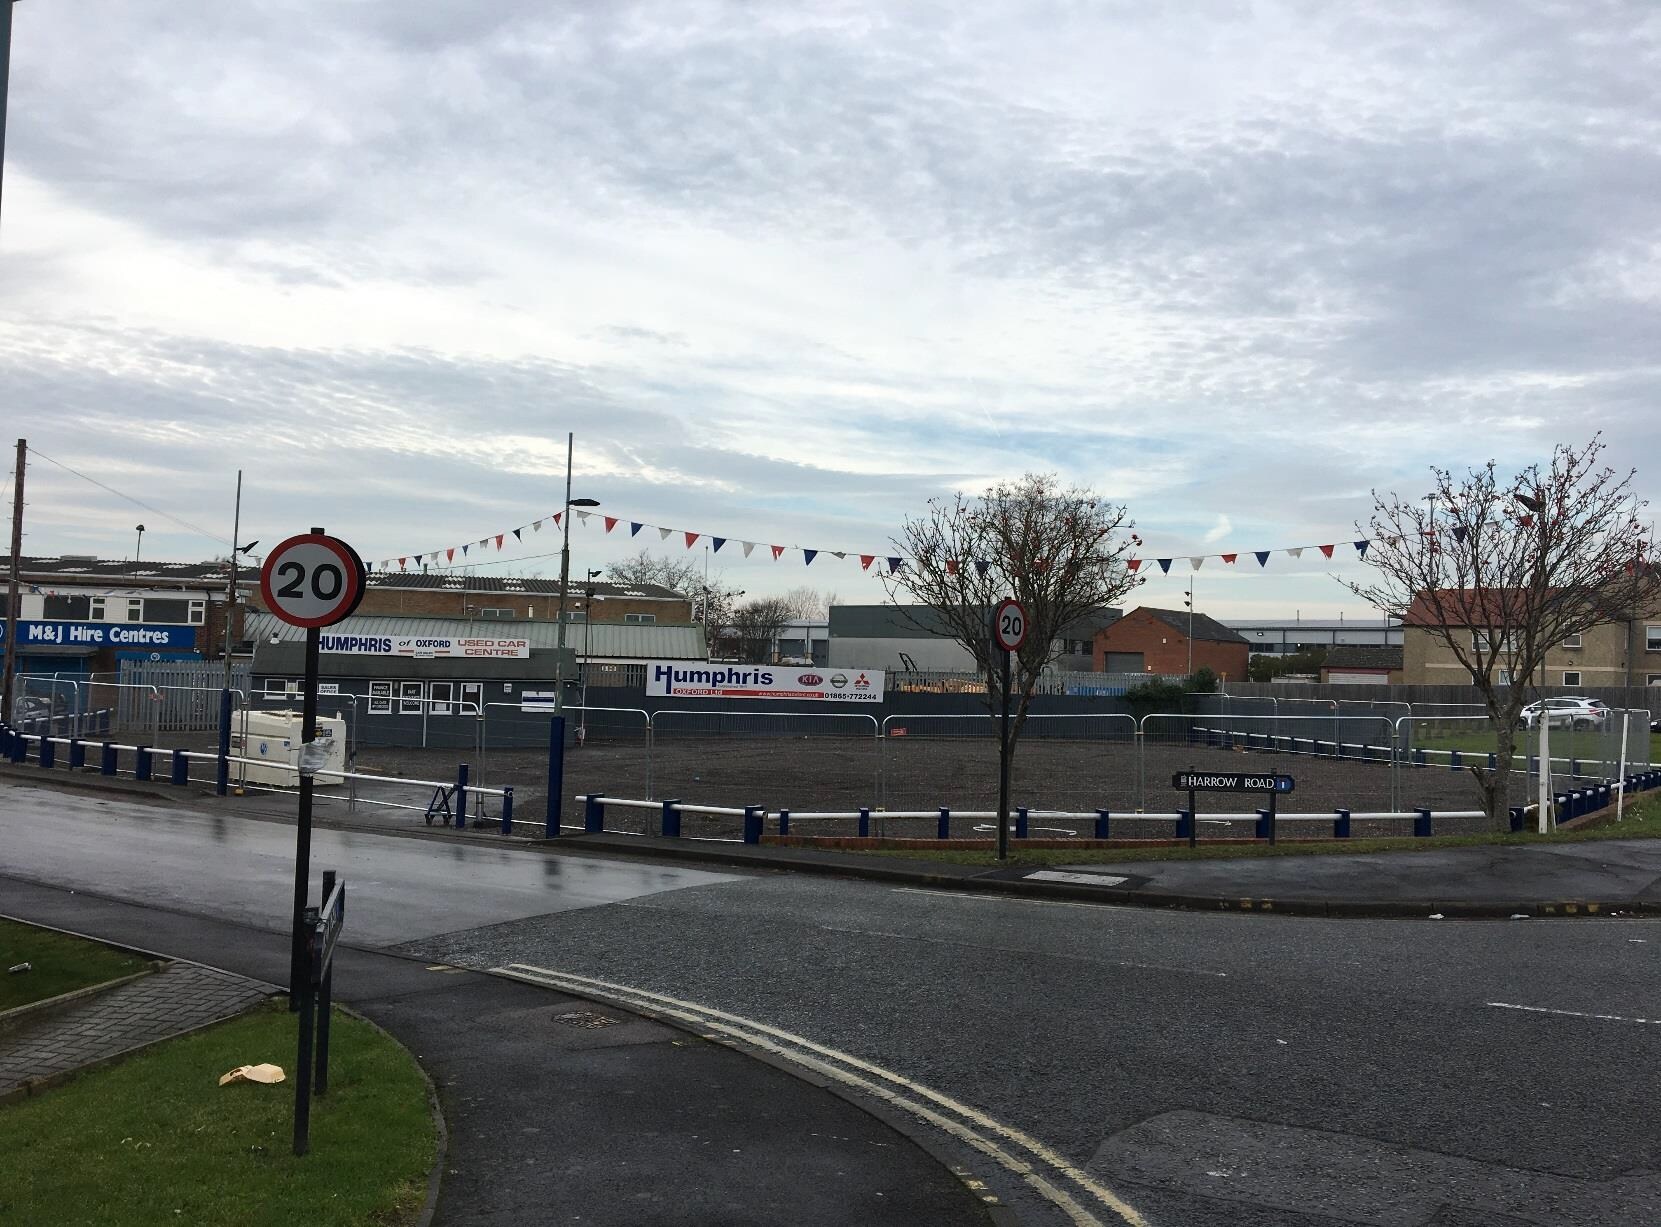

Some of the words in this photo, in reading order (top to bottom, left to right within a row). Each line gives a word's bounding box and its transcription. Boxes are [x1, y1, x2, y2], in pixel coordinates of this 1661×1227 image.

[277, 562, 343, 600] 20
[1002, 615, 1021, 636] 20
[29, 625, 62, 643] M&J
[70, 626, 103, 642] Hire
[109, 627, 169, 643] Centres
[319, 635, 392, 653] HUMPHRIS
[398, 639, 412, 647] of
[415, 639, 451, 648] OXFORD
[457, 639, 494, 647] USED
[497, 640, 527, 648] CAR
[464, 648, 519, 657] CENTRE
[655, 665, 774, 694] Humphris
[802, 675, 820, 684] KIA
[675, 688, 709, 696] OXFORD
[1188, 775, 1237, 788] HARROW
[1244, 777, 1275, 789] ROAD
